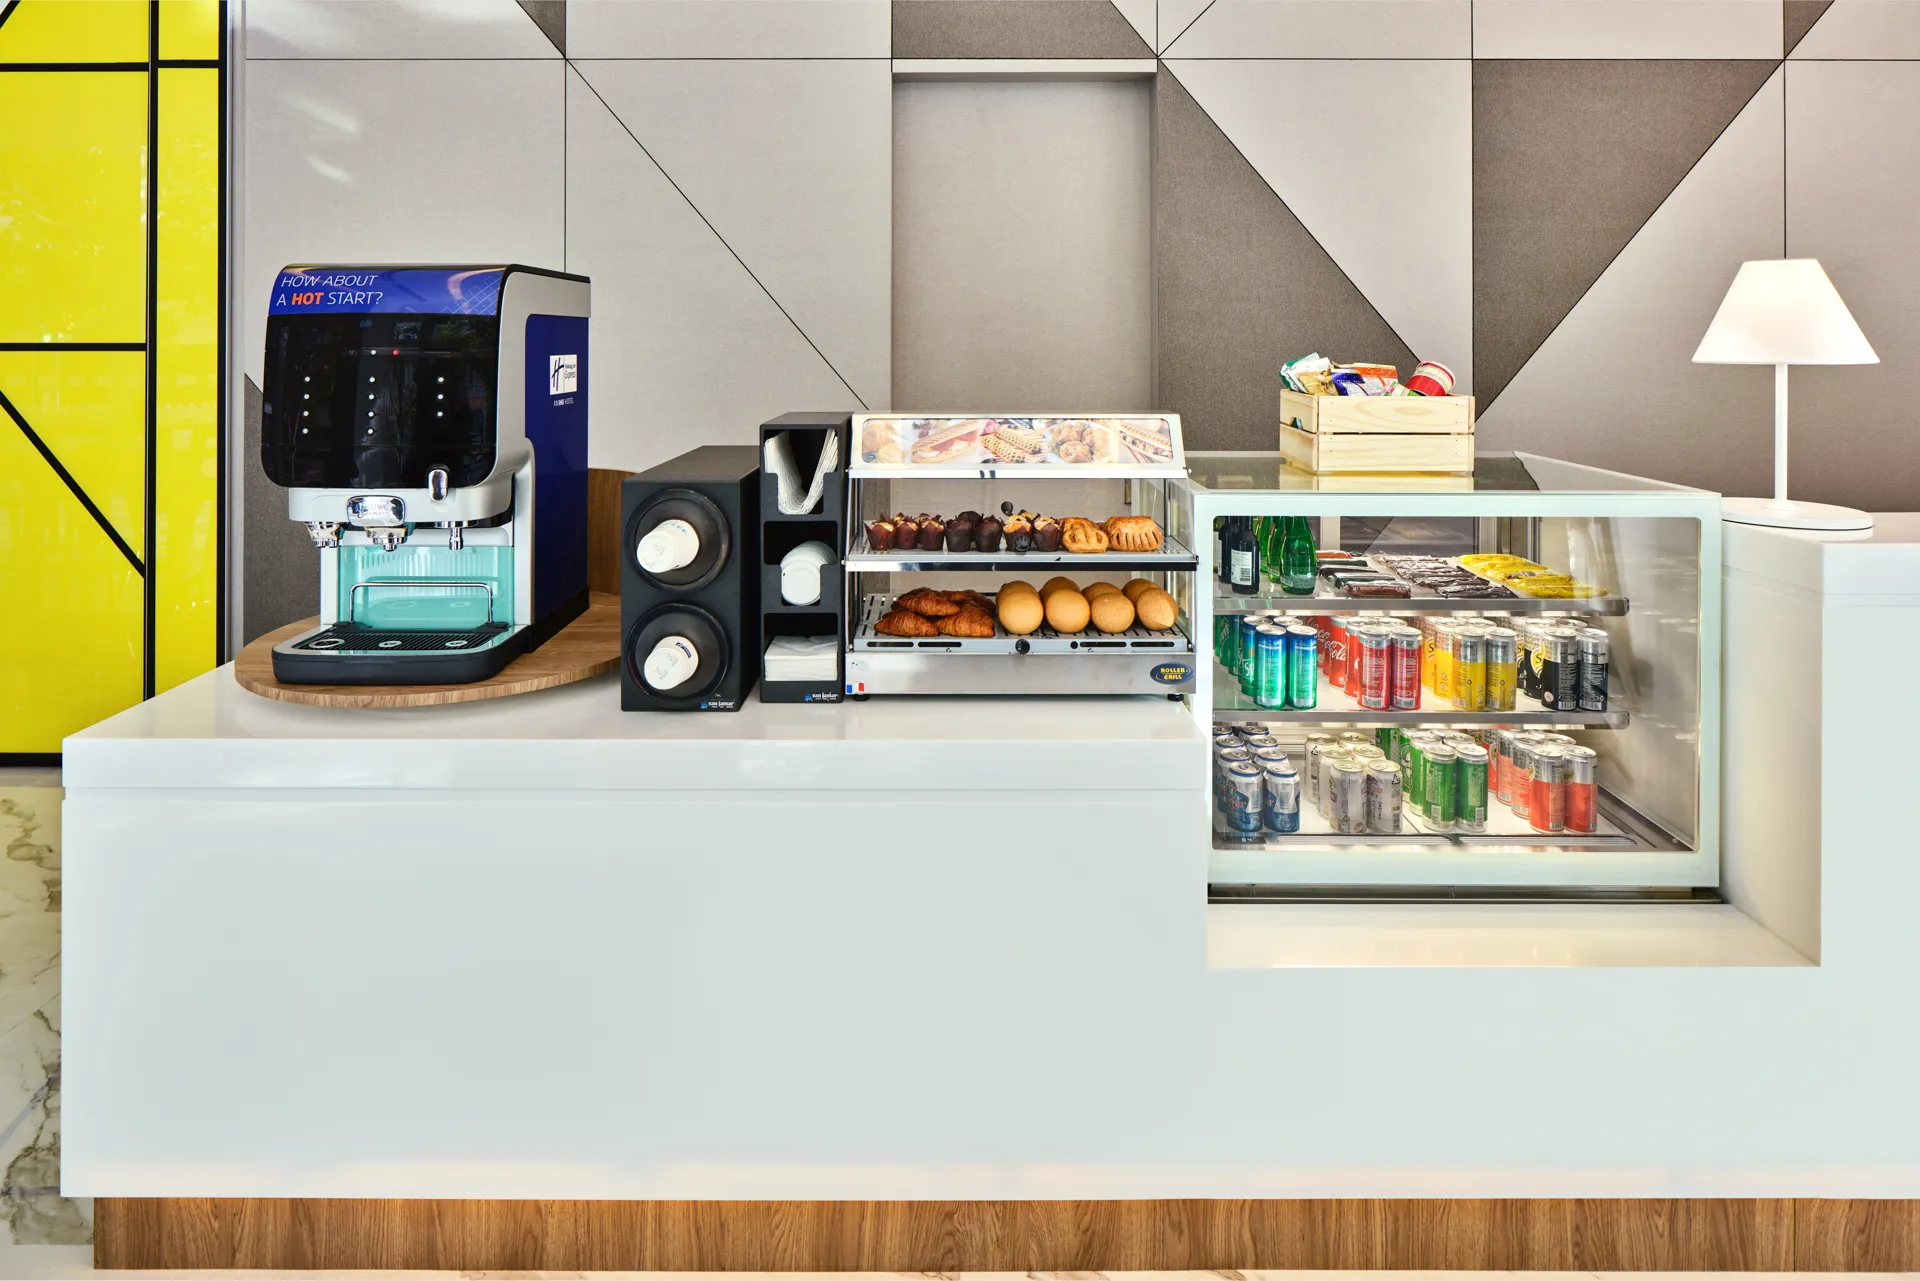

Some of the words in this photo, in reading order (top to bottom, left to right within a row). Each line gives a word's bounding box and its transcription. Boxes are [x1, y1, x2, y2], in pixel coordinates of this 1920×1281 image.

[281, 275, 321, 287] HOW
[322, 275, 378, 287] ABOUT
[276, 293, 287, 306] A
[291, 292, 324, 305] HOT
[327, 291, 383, 304] START?
